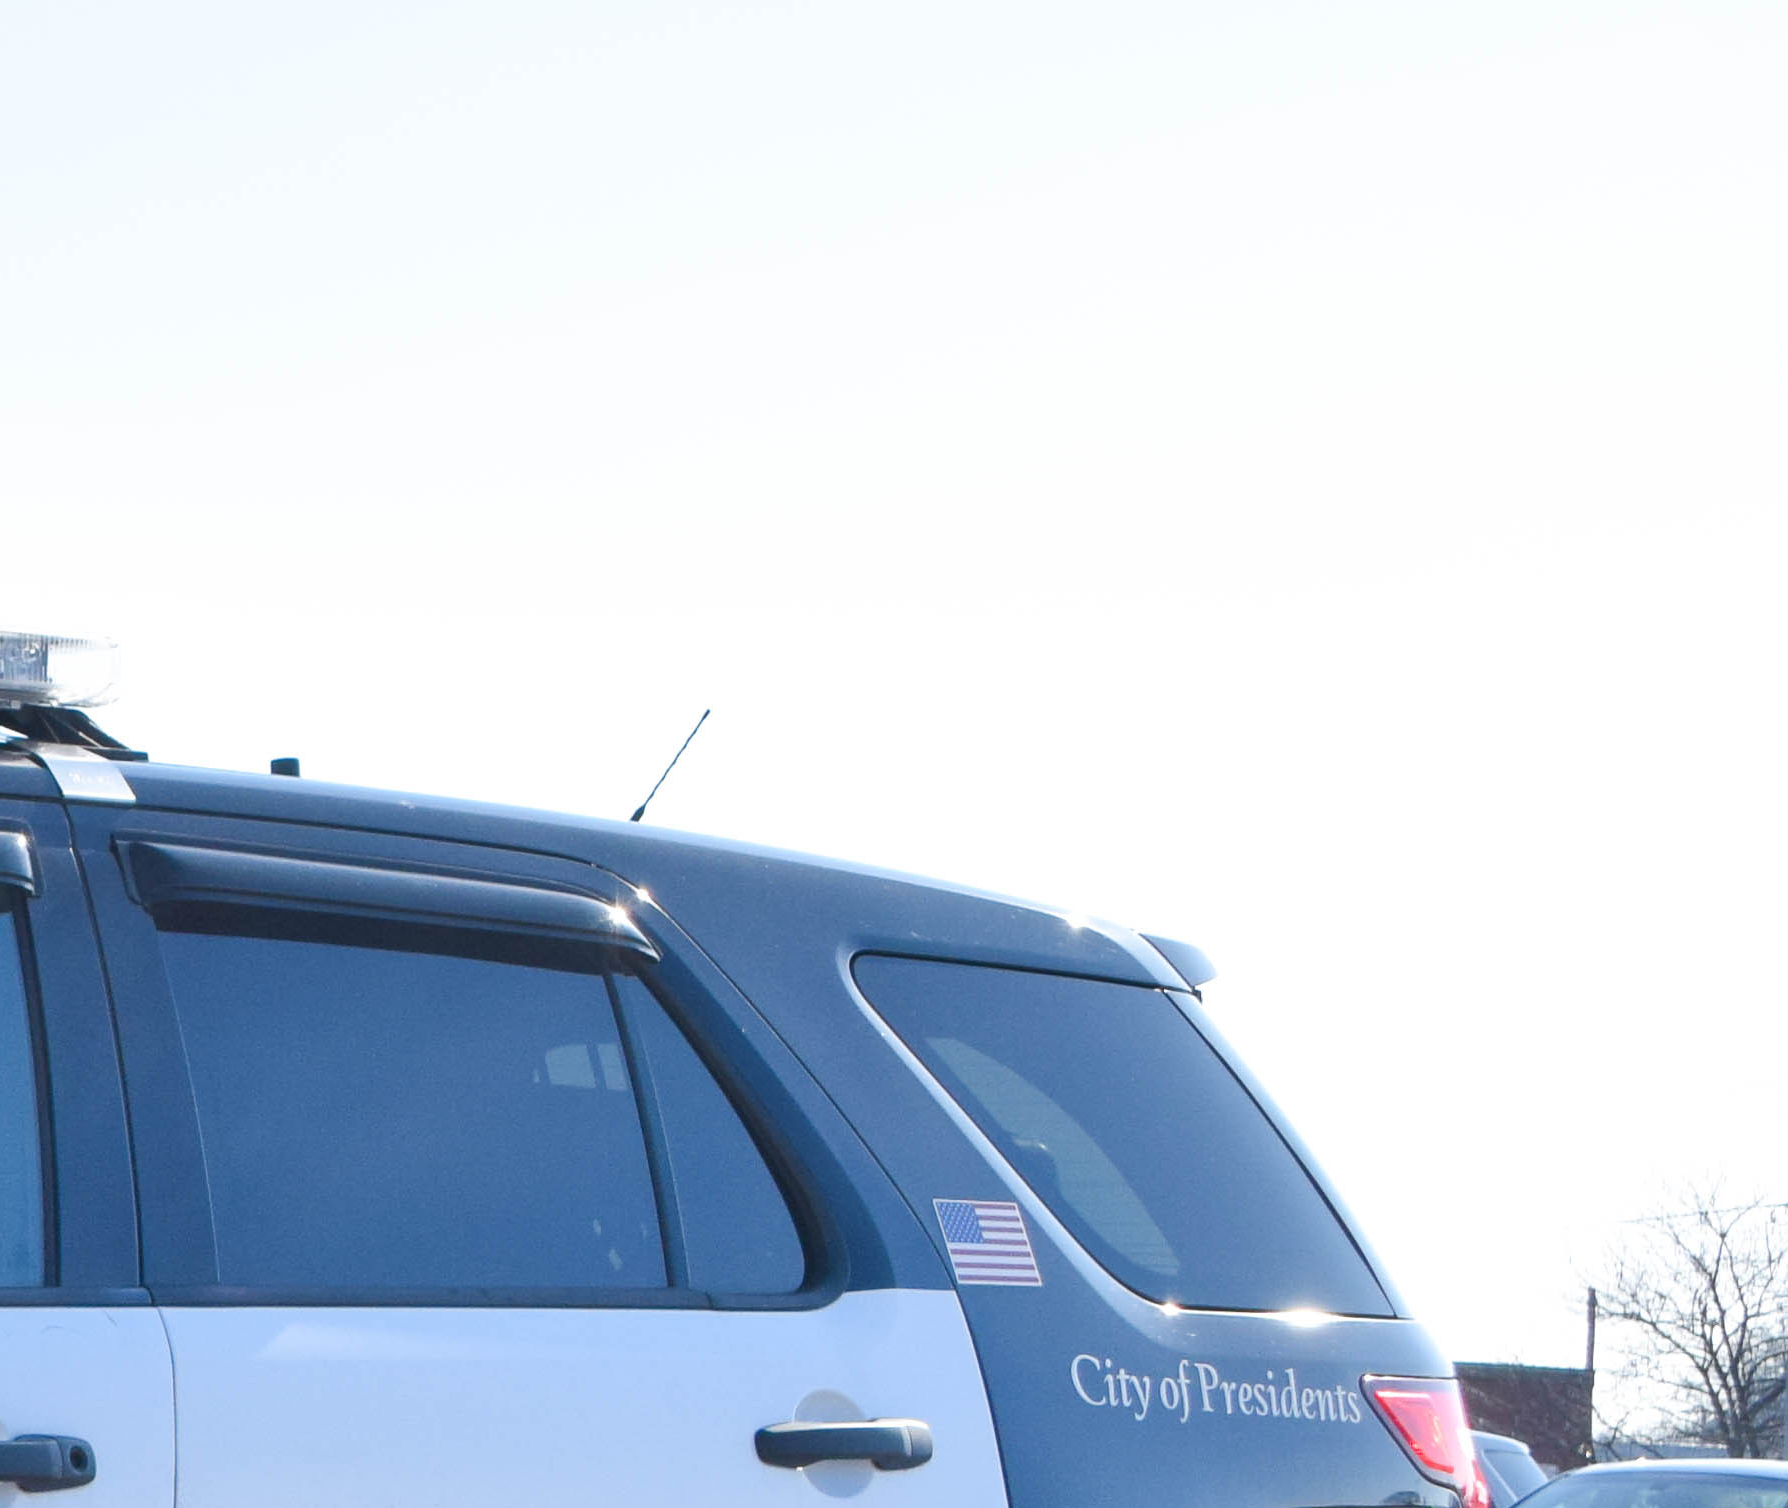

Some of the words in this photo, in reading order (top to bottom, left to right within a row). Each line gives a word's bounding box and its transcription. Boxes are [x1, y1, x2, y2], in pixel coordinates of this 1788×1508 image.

[1070, 1353, 1151, 1422] City
[1159, 1359, 1192, 1424] of
[1194, 1362, 1362, 1424] Presidents
